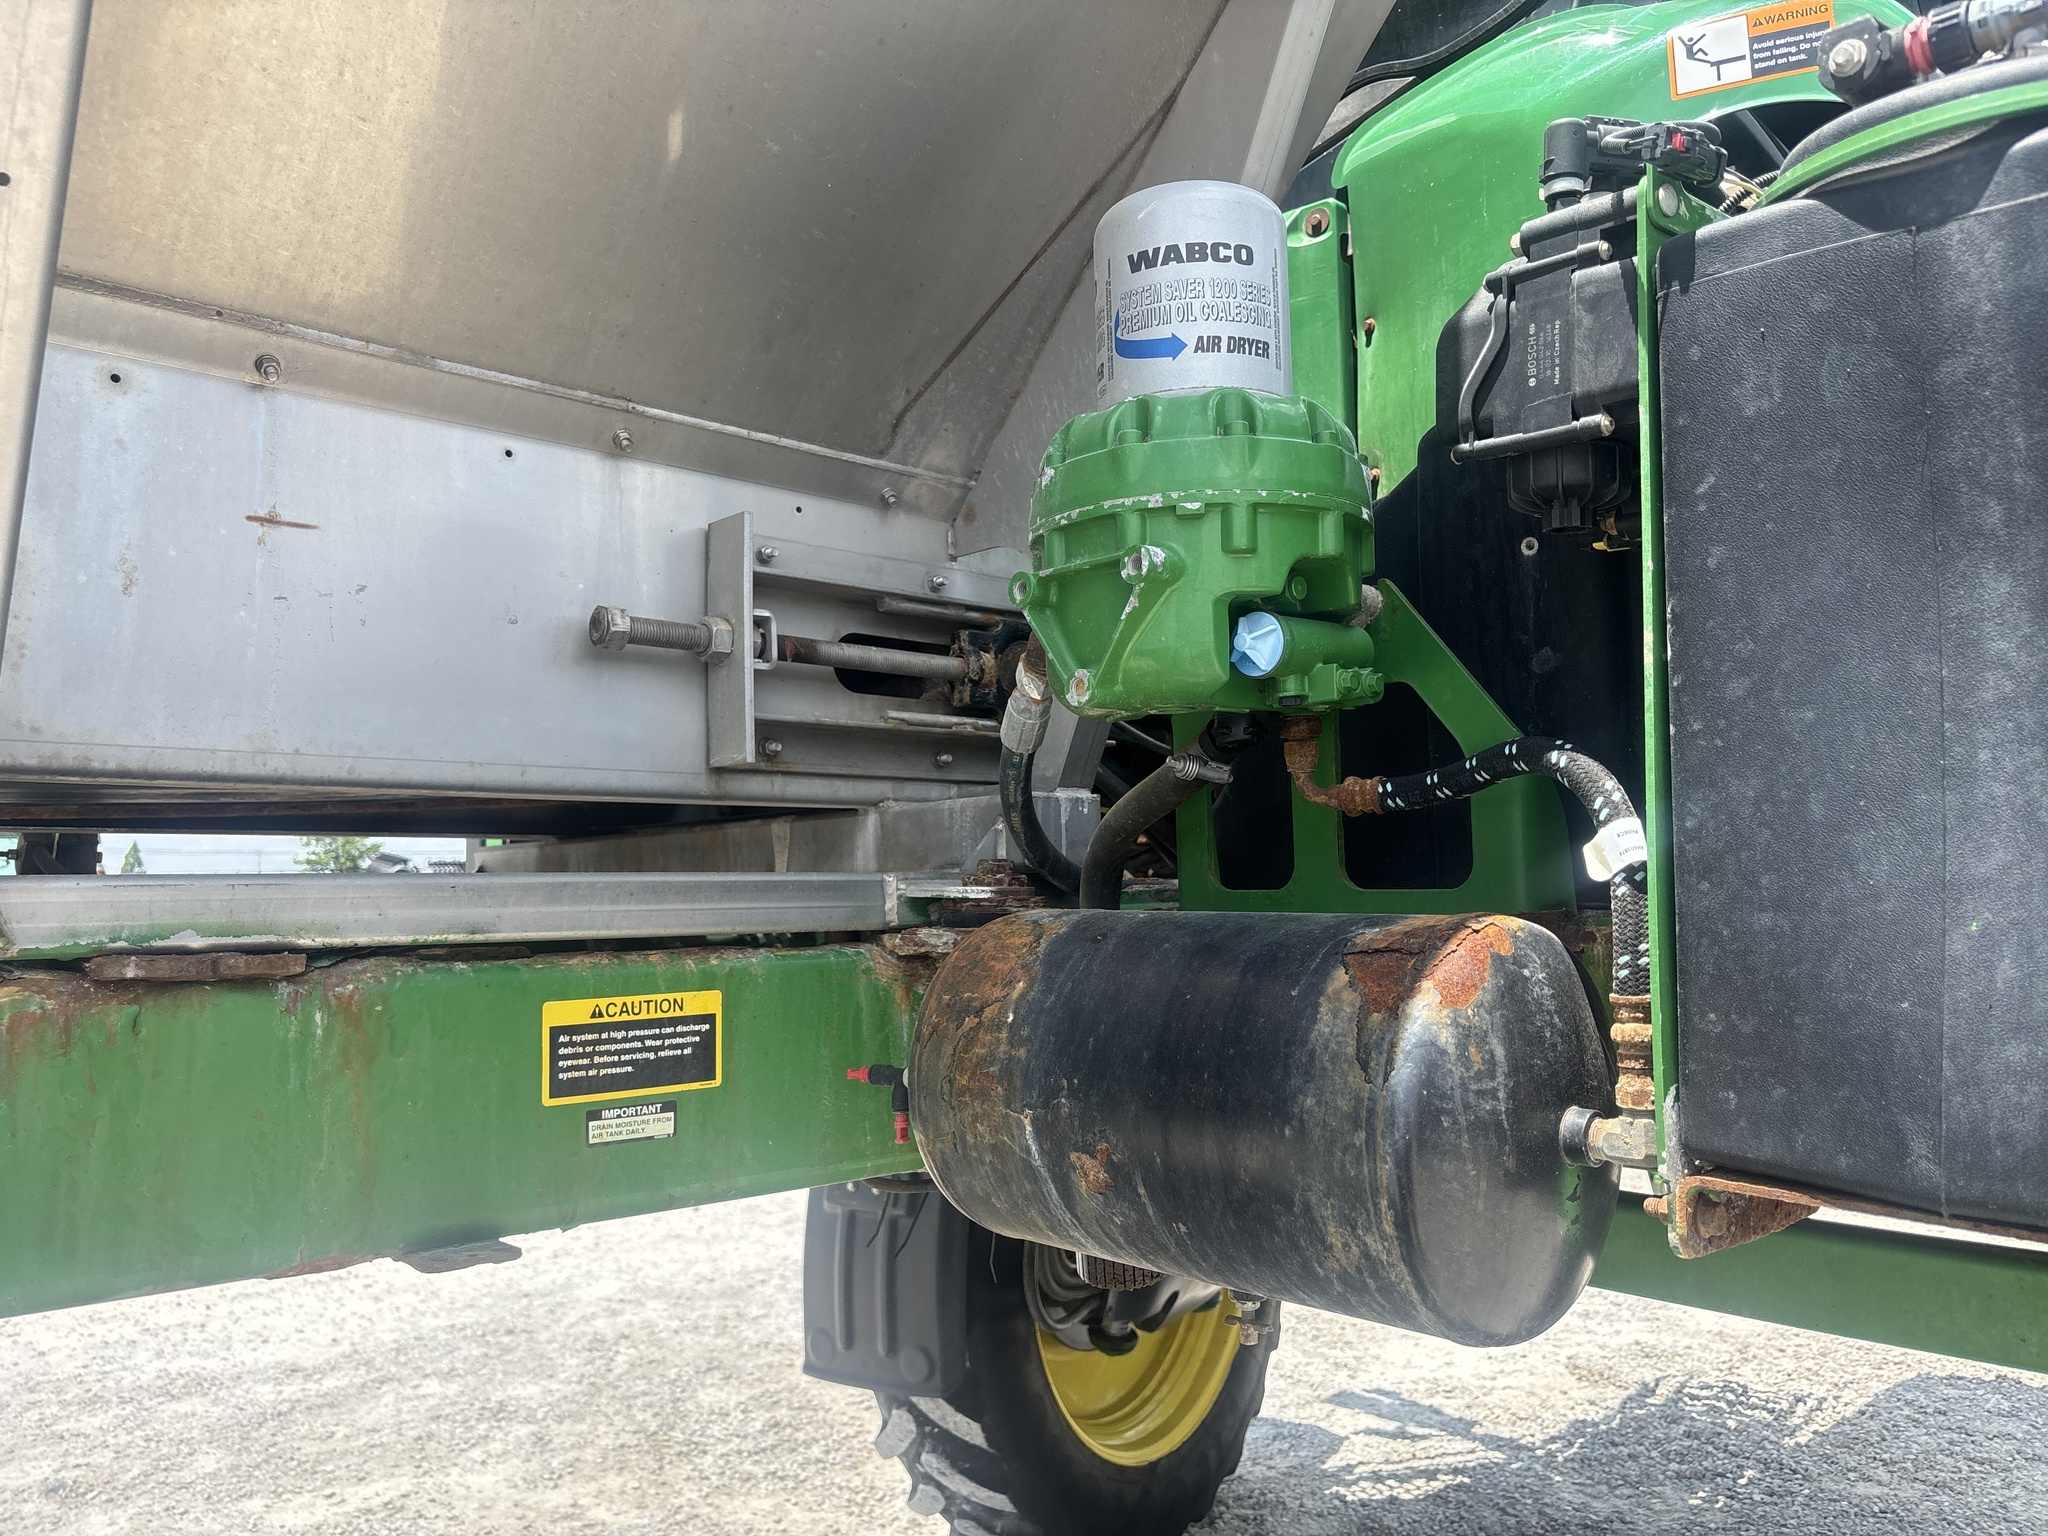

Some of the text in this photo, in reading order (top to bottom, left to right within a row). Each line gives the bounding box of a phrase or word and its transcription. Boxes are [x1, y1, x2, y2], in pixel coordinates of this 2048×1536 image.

[1764, 4, 1829, 25] WARNING
[1753, 30, 1827, 50] Avoid serious injur
[1753, 51, 1771, 59] from
[1772, 46, 1798, 55] falling.
[1754, 59, 1776, 69] stand
[1788, 53, 1808, 61] tank.
[1127, 242, 1254, 274] WABCO
[1120, 278, 1271, 313] SYSTEM SAVER 1200 SERIES
[1120, 300, 1271, 336] PREMIUM OIL COALESCING
[1193, 335, 1270, 359] AIR DRYER
[1528, 336, 1536, 376] BOSCH
[1554, 357, 1560, 365] in
[606, 998, 683, 1018] CAUTION
[572, 1033, 599, 1043] system
[610, 1030, 626, 1039] high
[628, 1028, 660, 1038] pressure
[676, 1024, 710, 1032] discharge
[558, 1046, 583, 1054] debris
[595, 1041, 643, 1051] components.
[665, 1035, 700, 1046] protective
[558, 1058, 592, 1068] eyewear.
[594, 1054, 619, 1063] Before
[621, 1051, 656, 1060] servicing,
[658, 1049, 682, 1057] relieve
[558, 1066, 634, 1080] system air pressure.
[602, 1104, 662, 1119] IMPORTANT
[615, 1119, 651, 1129] MOISTURE
[653, 1116, 672, 1124] FROM
[606, 1130, 623, 1138] TANK
